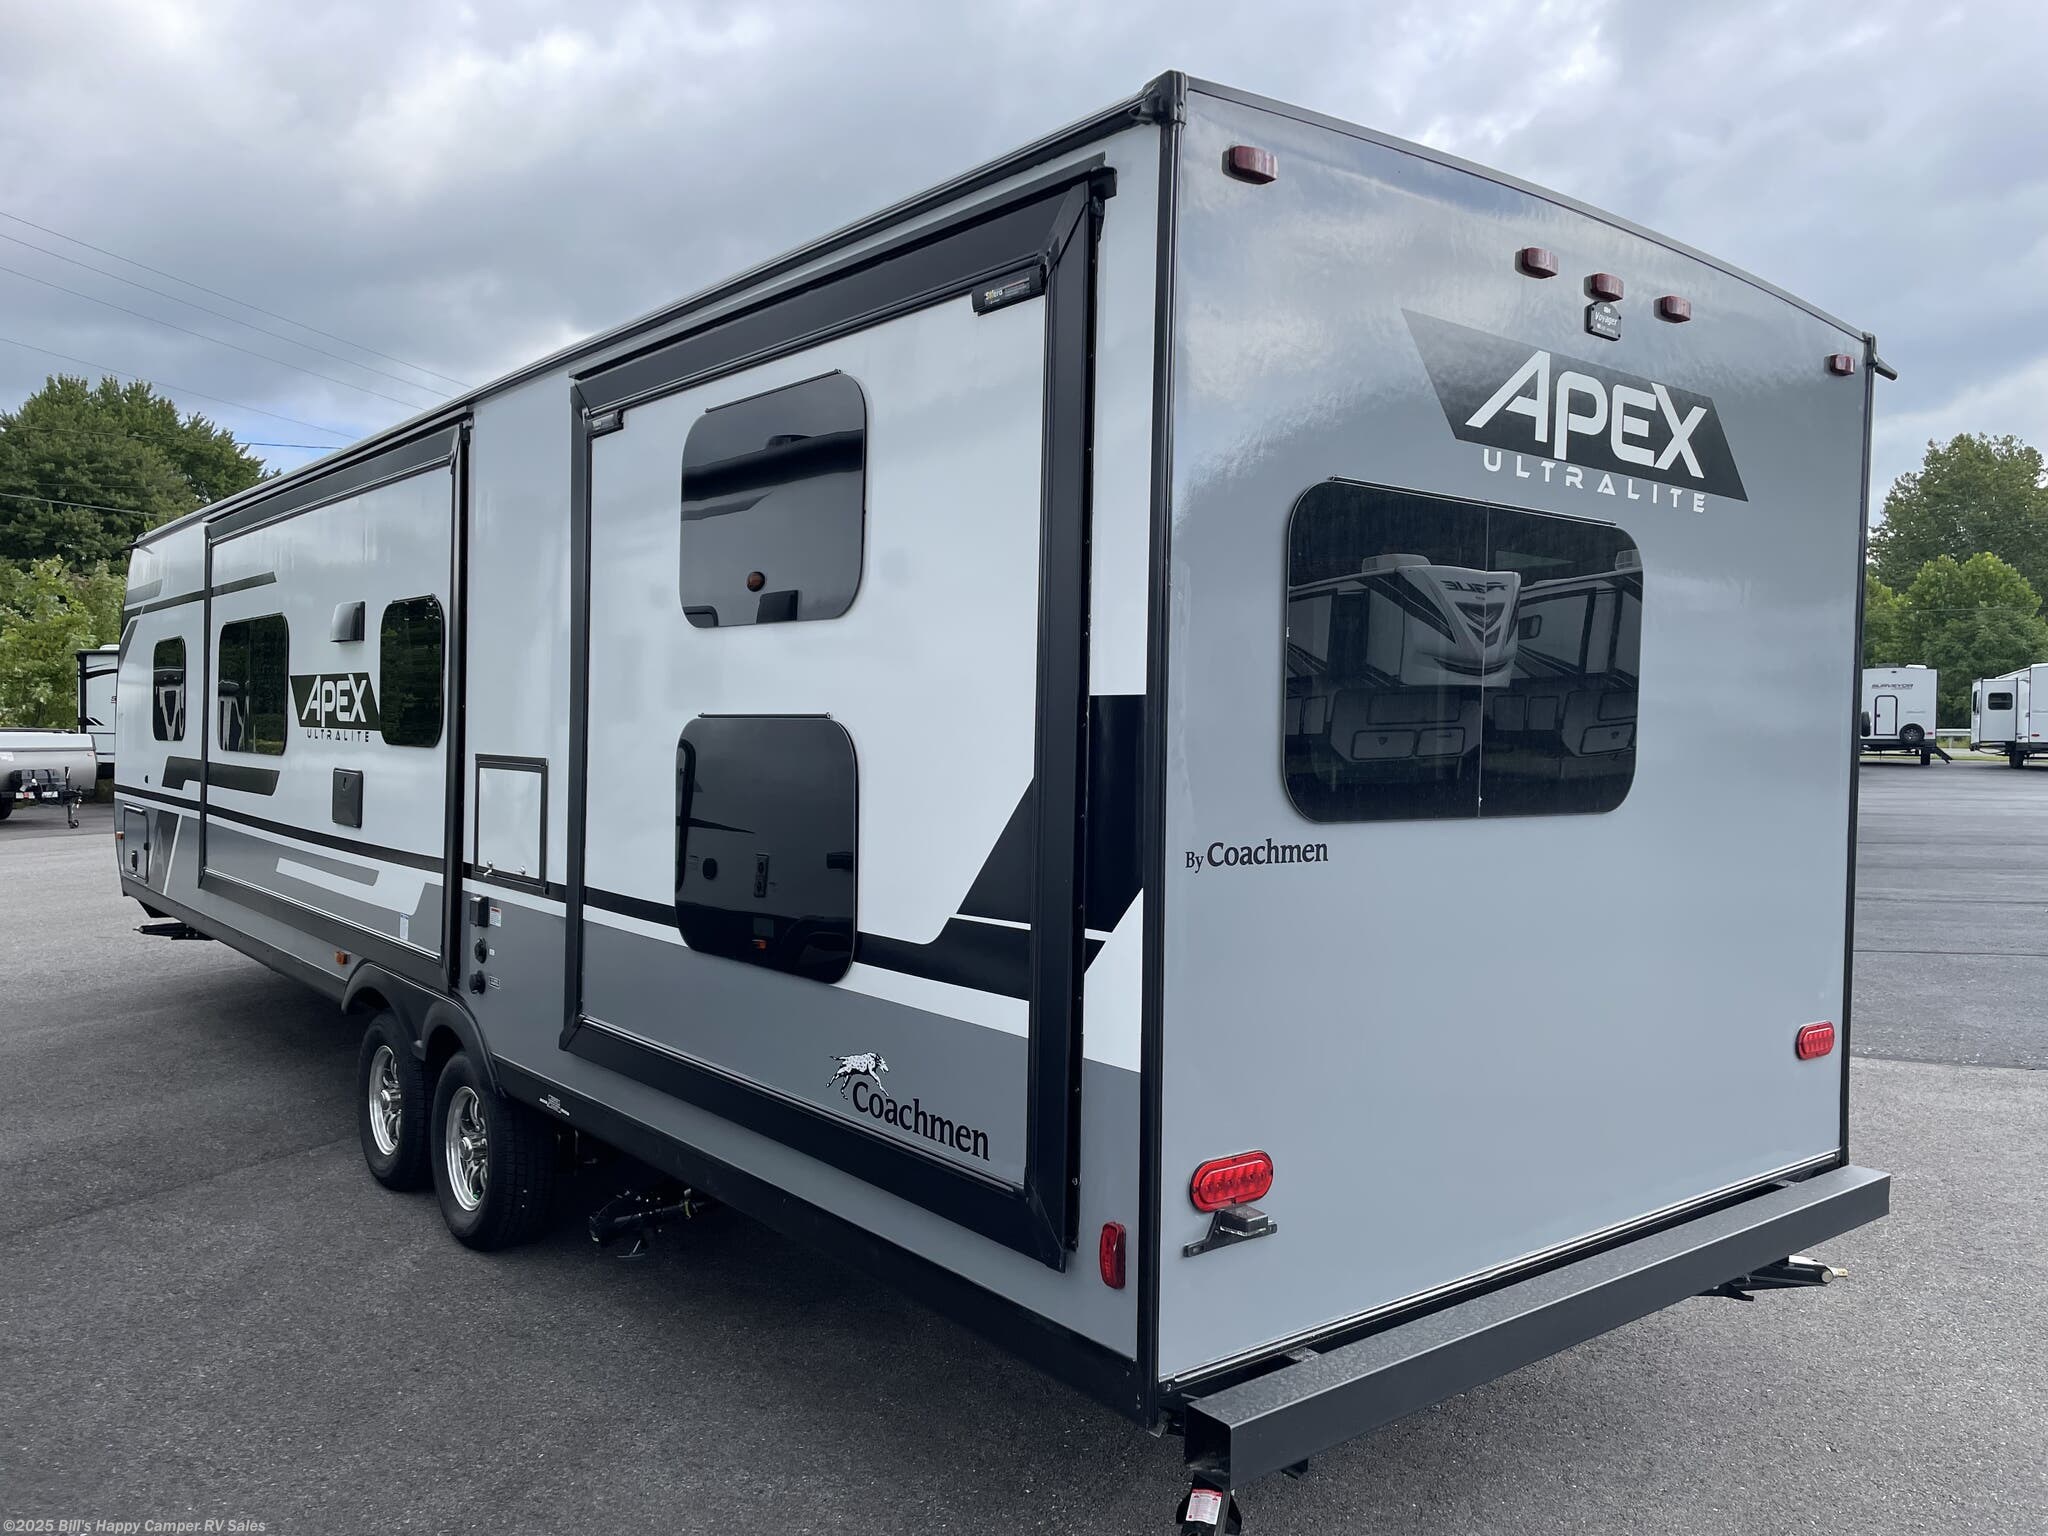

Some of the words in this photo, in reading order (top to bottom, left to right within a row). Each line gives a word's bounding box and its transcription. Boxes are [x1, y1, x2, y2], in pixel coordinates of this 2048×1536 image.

[1465, 350, 1708, 479] APEX
[1484, 448, 1706, 513] ULTRALITE
[301, 674, 367, 728] APEX
[306, 729, 369, 743] ULTRALITE
[1185, 851, 1204, 873] By
[1207, 838, 1328, 867] Coachmen
[852, 1081, 990, 1161] Coachmen
